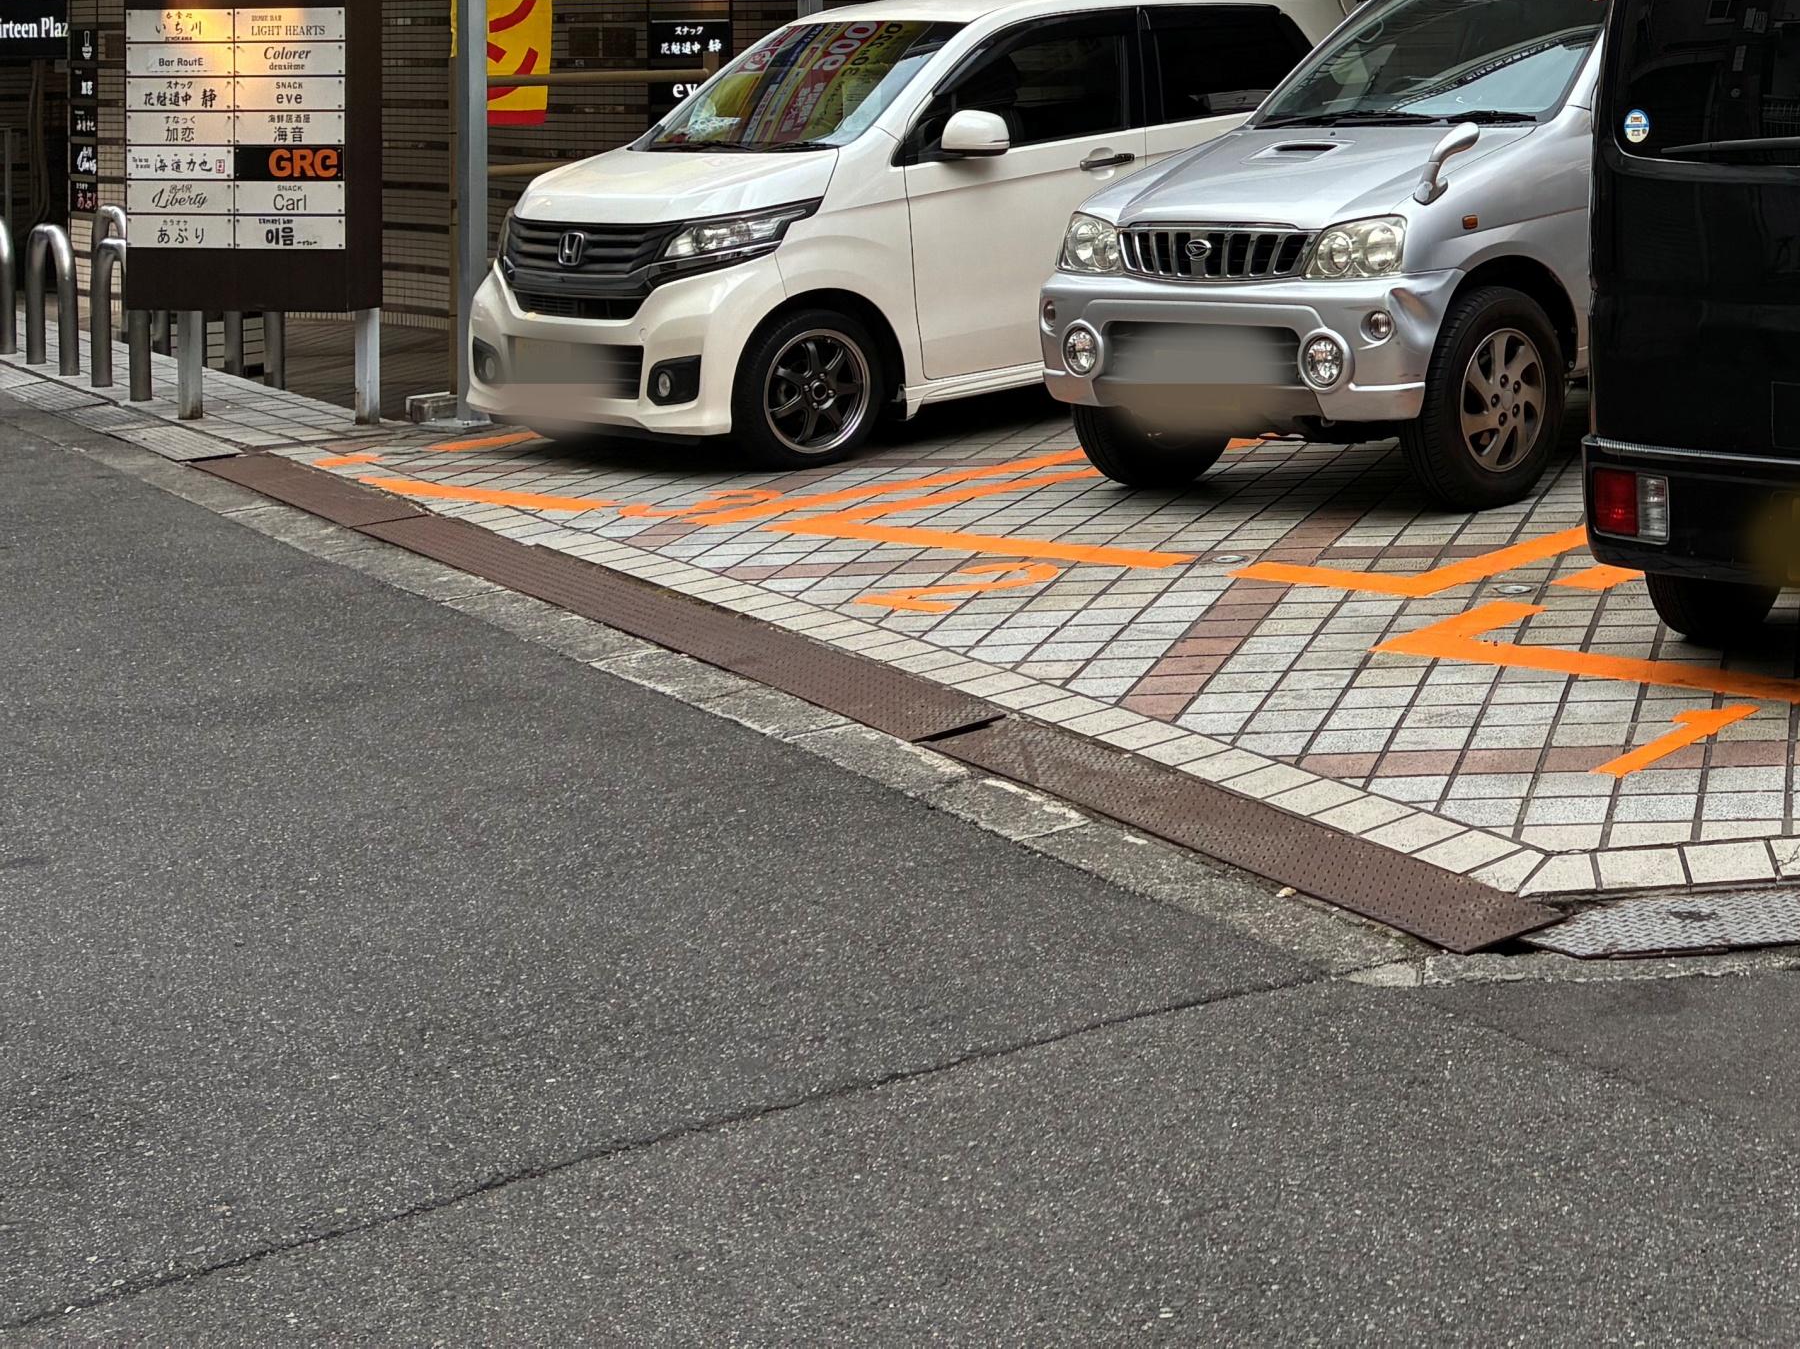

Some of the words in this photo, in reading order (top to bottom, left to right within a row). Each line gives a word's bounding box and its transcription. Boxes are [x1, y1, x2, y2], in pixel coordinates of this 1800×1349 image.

[251, 25, 282, 36] LIGHT
[285, 25, 326, 36] HEARTS
[674, 25, 704, 36] スナック
[263, 46, 312, 60] Colorer
[158, 57, 175, 67] Bar
[166, 80, 194, 90] スナック
[275, 81, 304, 90] SNACK
[276, 93, 303, 105] eve
[164, 115, 196, 125] すなっく
[268, 113, 311, 124] 海鮮居酒屋
[164, 126, 195, 143] 加恋
[273, 126, 305, 143] 海音
[276, 184, 303, 192] SNACK
[151, 188, 208, 209] Liberty
[273, 193, 307, 211] Carl
